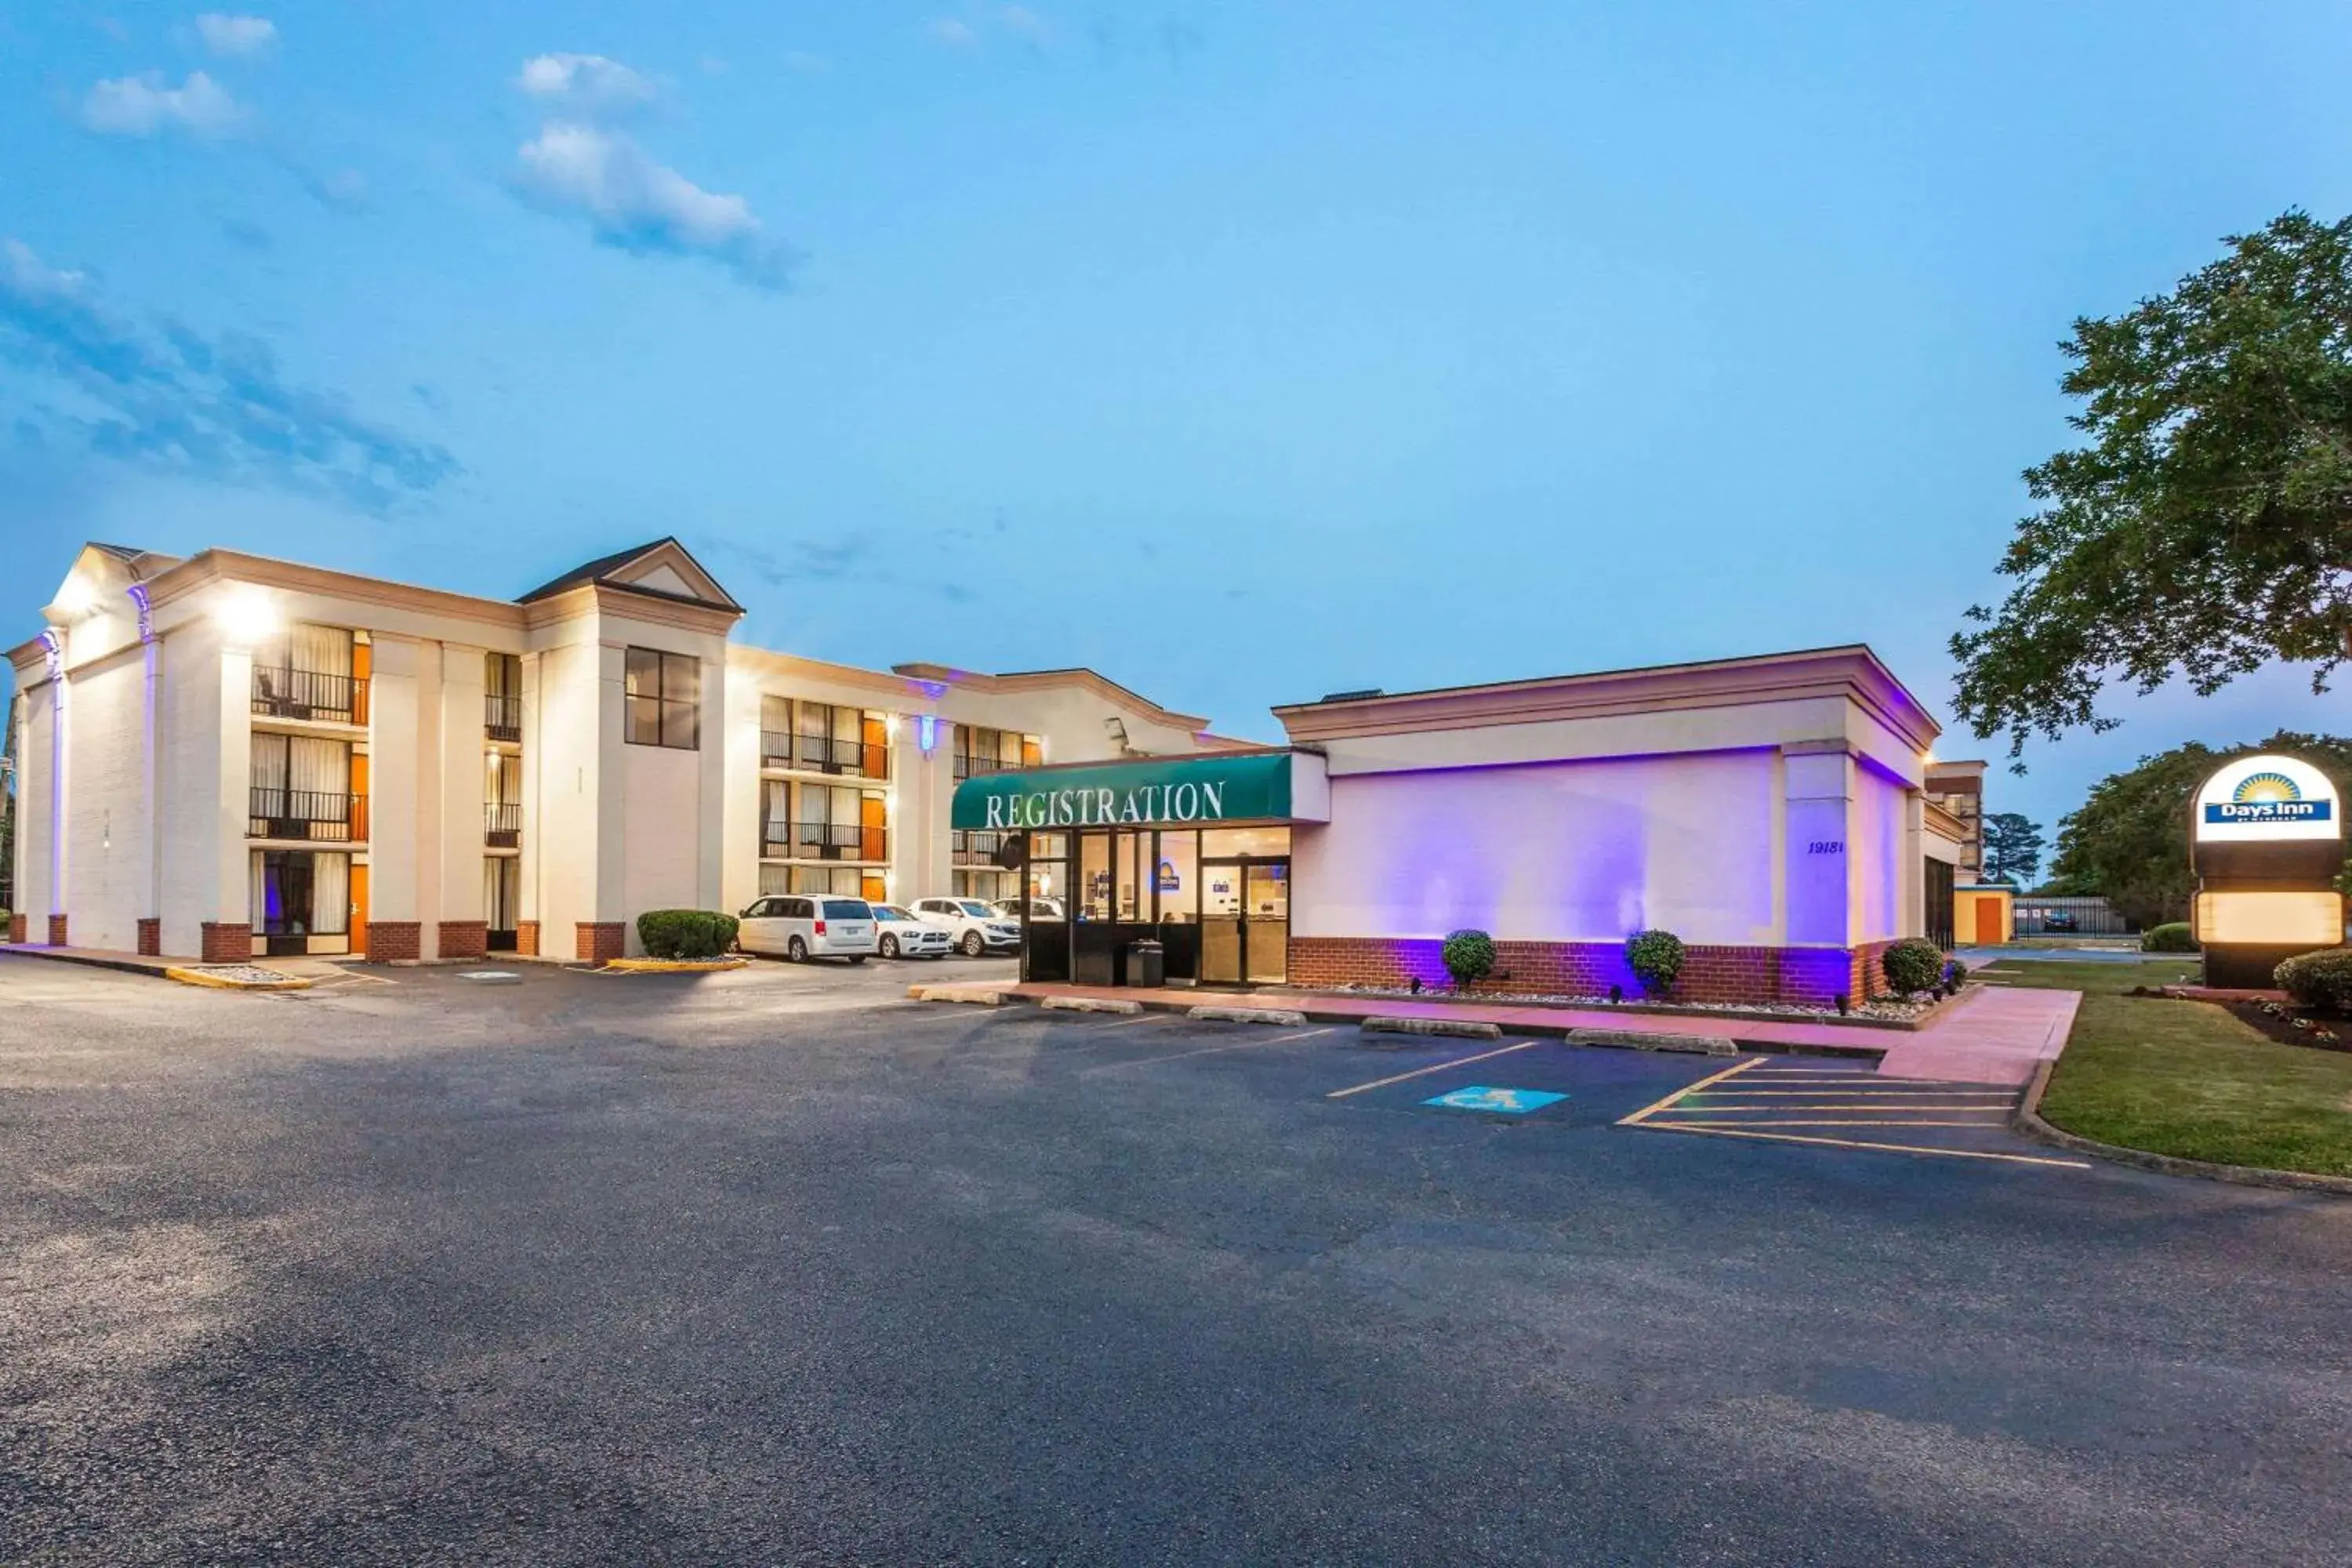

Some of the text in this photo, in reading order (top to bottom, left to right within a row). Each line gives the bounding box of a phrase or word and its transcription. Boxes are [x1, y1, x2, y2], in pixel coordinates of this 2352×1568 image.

[985, 781, 1227, 829] REGISTRATION
[2221, 802, 2314, 817] Days Inn
